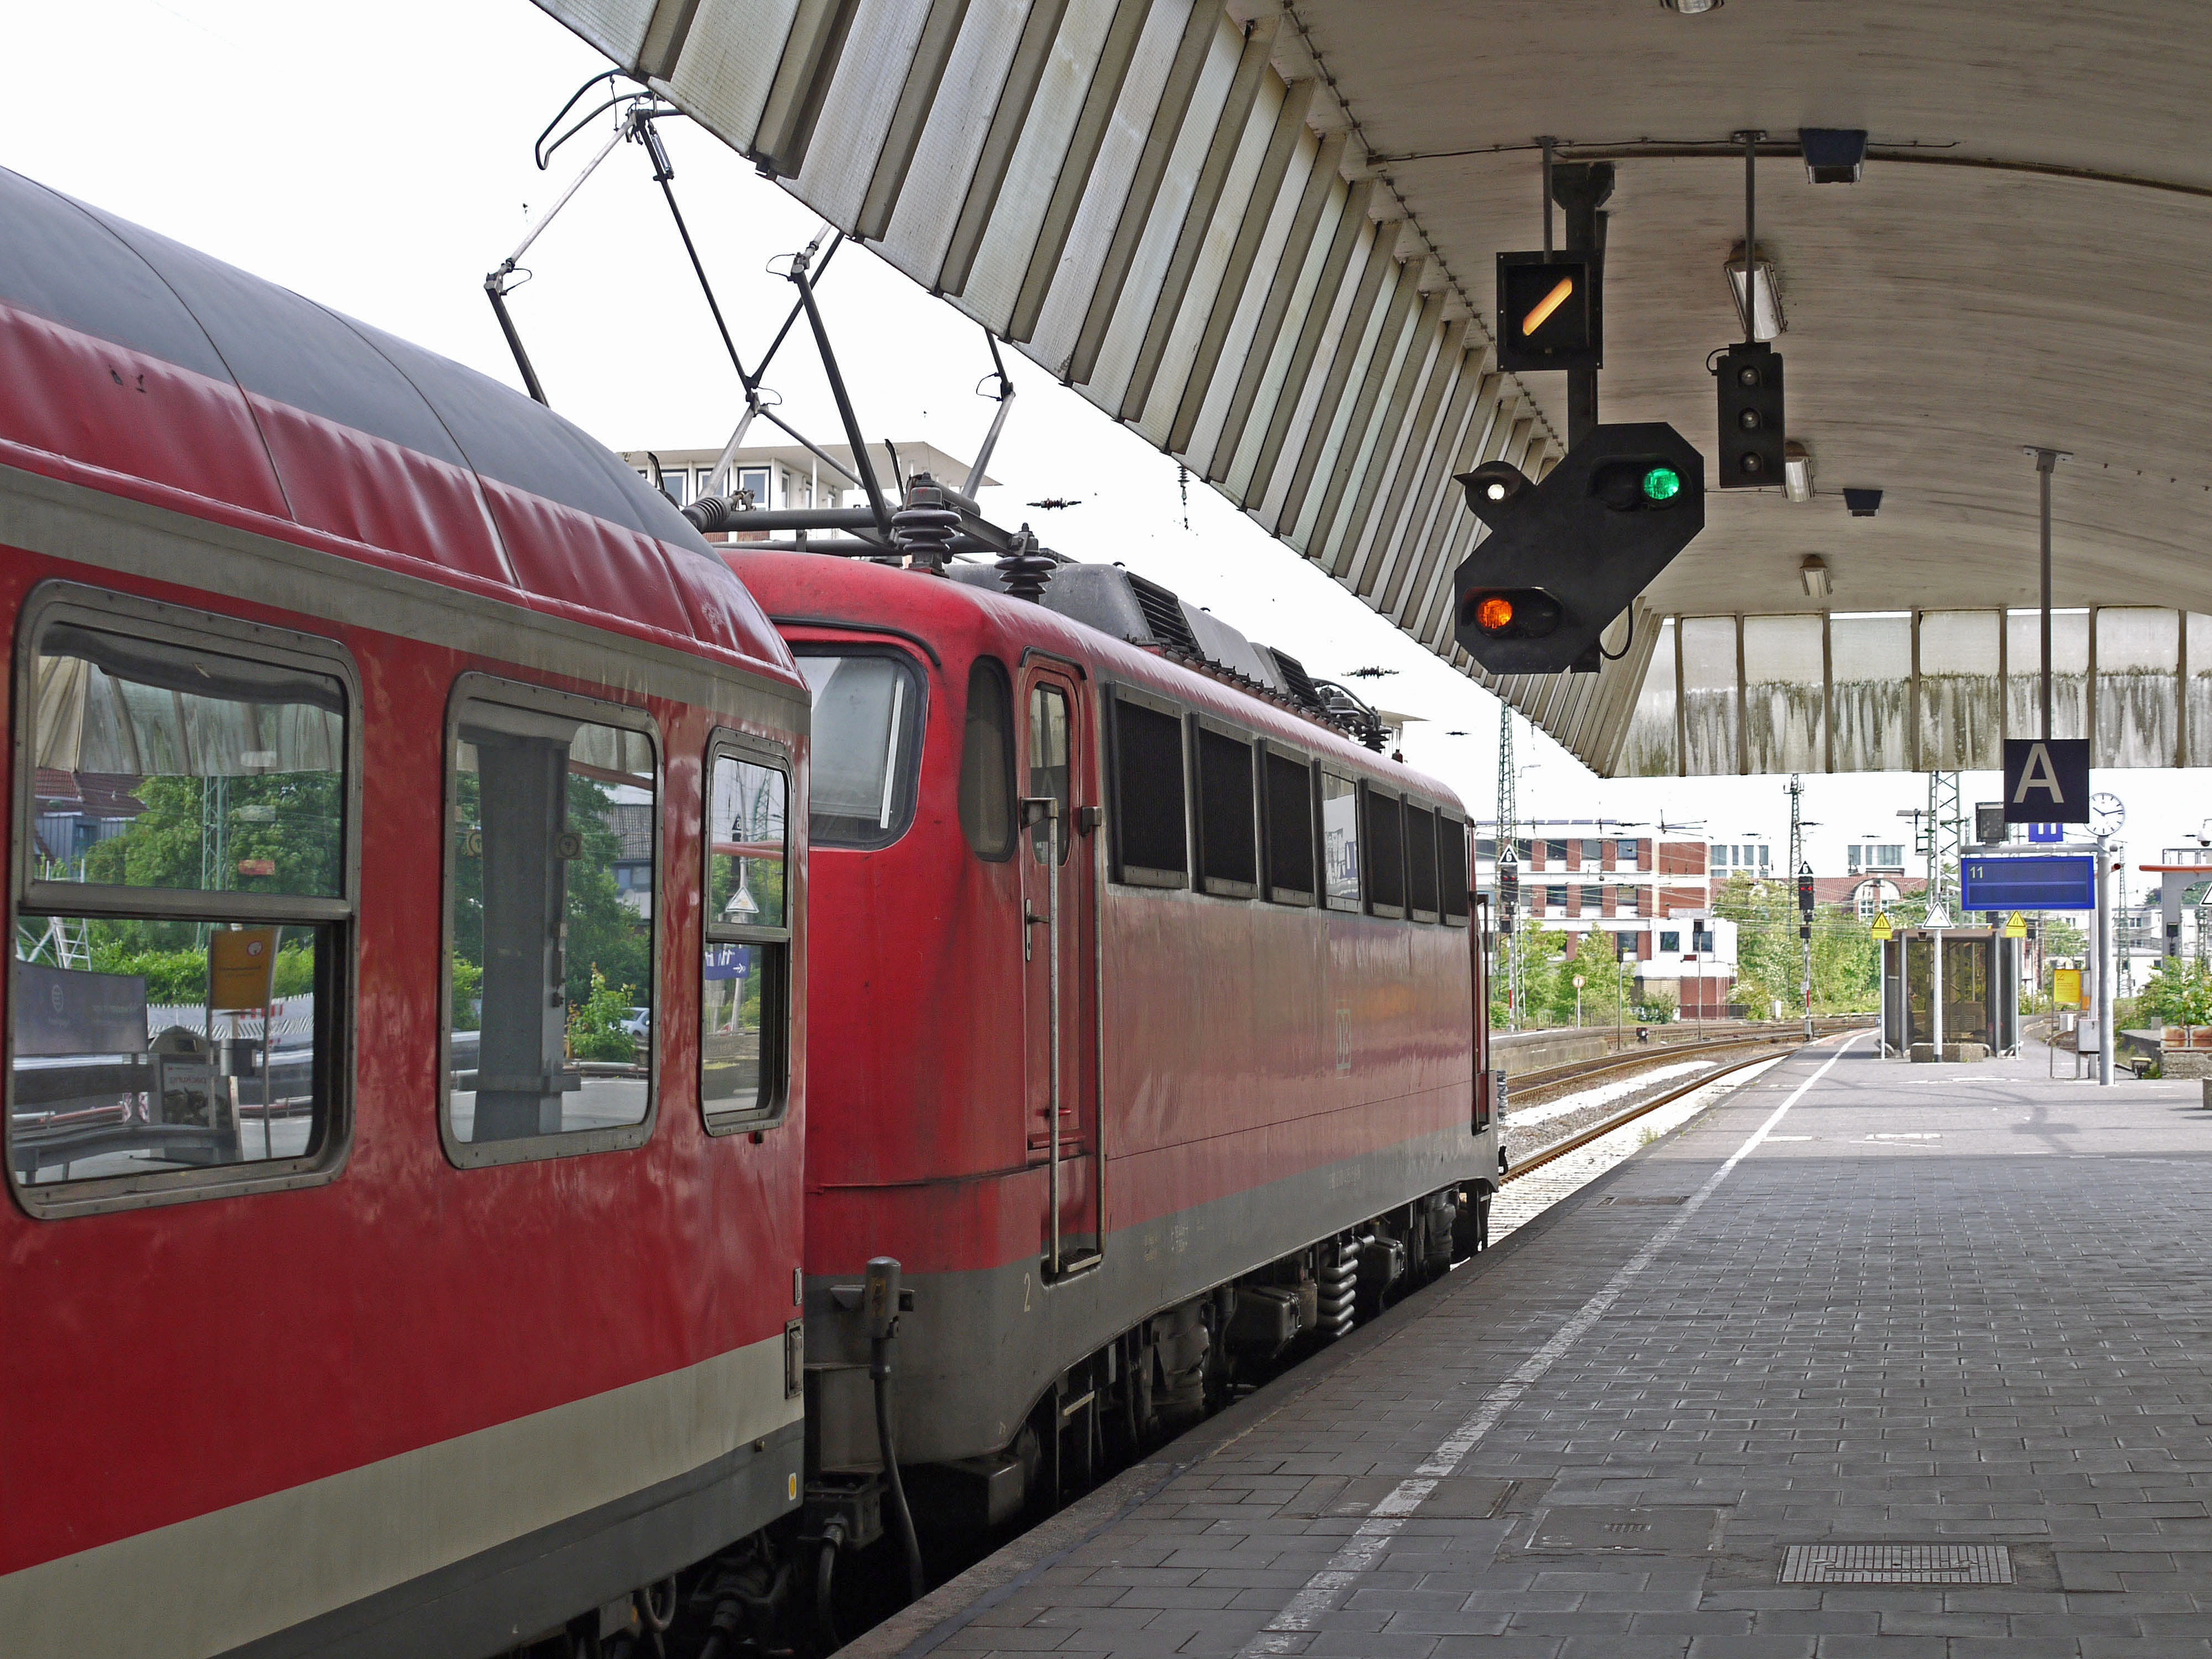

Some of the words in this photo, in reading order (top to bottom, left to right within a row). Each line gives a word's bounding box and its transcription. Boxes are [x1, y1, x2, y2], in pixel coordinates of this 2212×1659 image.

[2012, 743, 2065, 804] A
[1506, 851, 1512, 862] 6
[1803, 864, 1808, 874] 6
[1970, 867, 1983, 878] 11
[1024, 1272, 1031, 1313] 2
